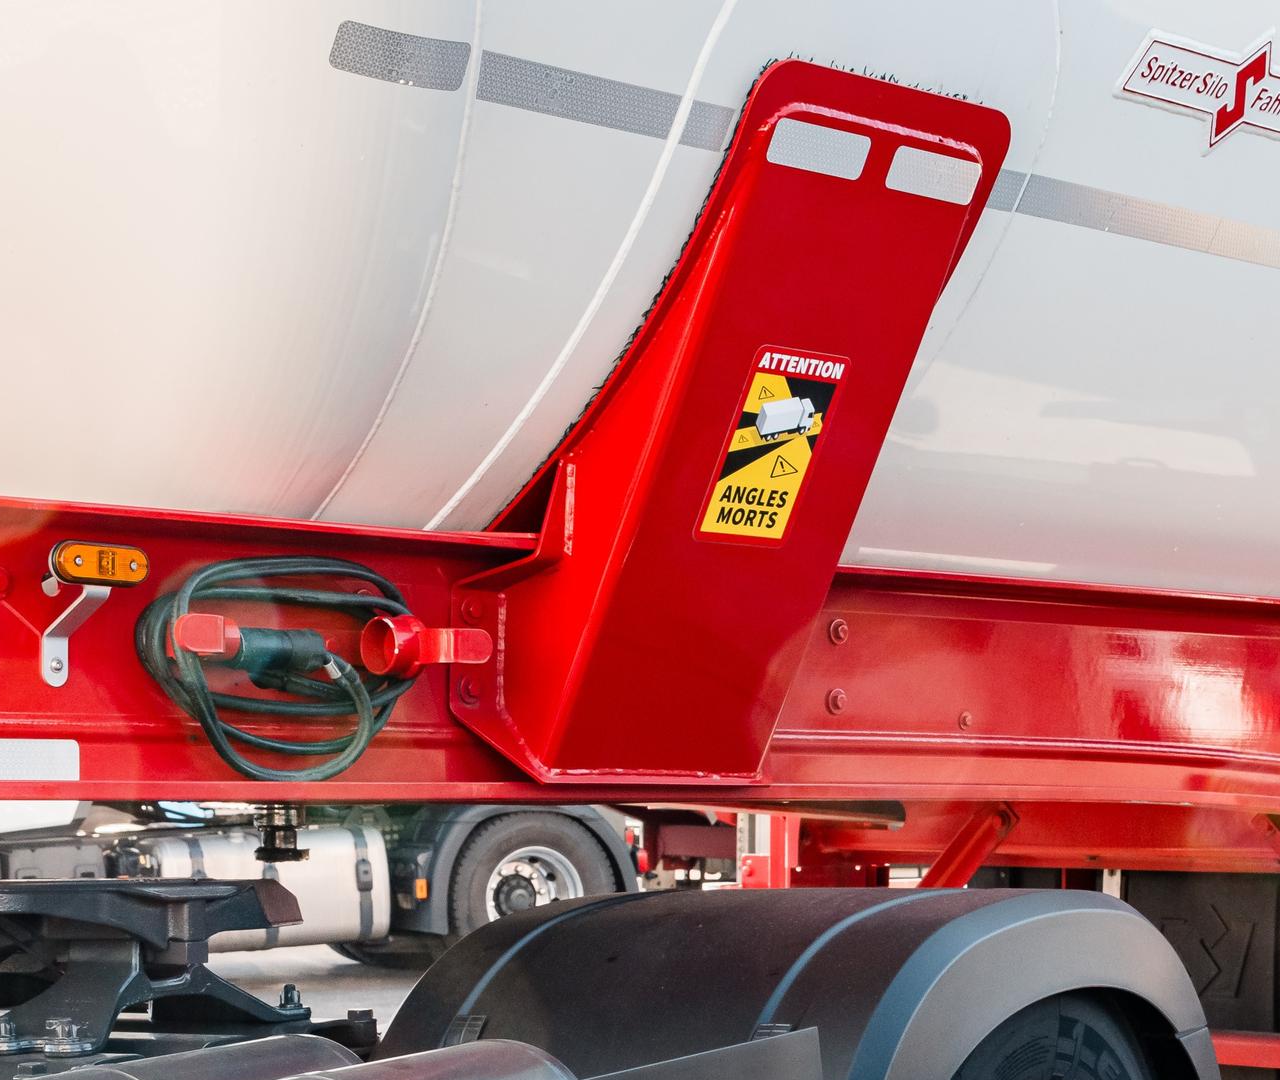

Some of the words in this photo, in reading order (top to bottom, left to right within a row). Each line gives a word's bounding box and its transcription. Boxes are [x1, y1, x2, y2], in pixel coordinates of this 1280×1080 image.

[758, 352, 845, 380] ATTENTION
[719, 485, 789, 509] ANGLES
[716, 506, 779, 529] MORTS
